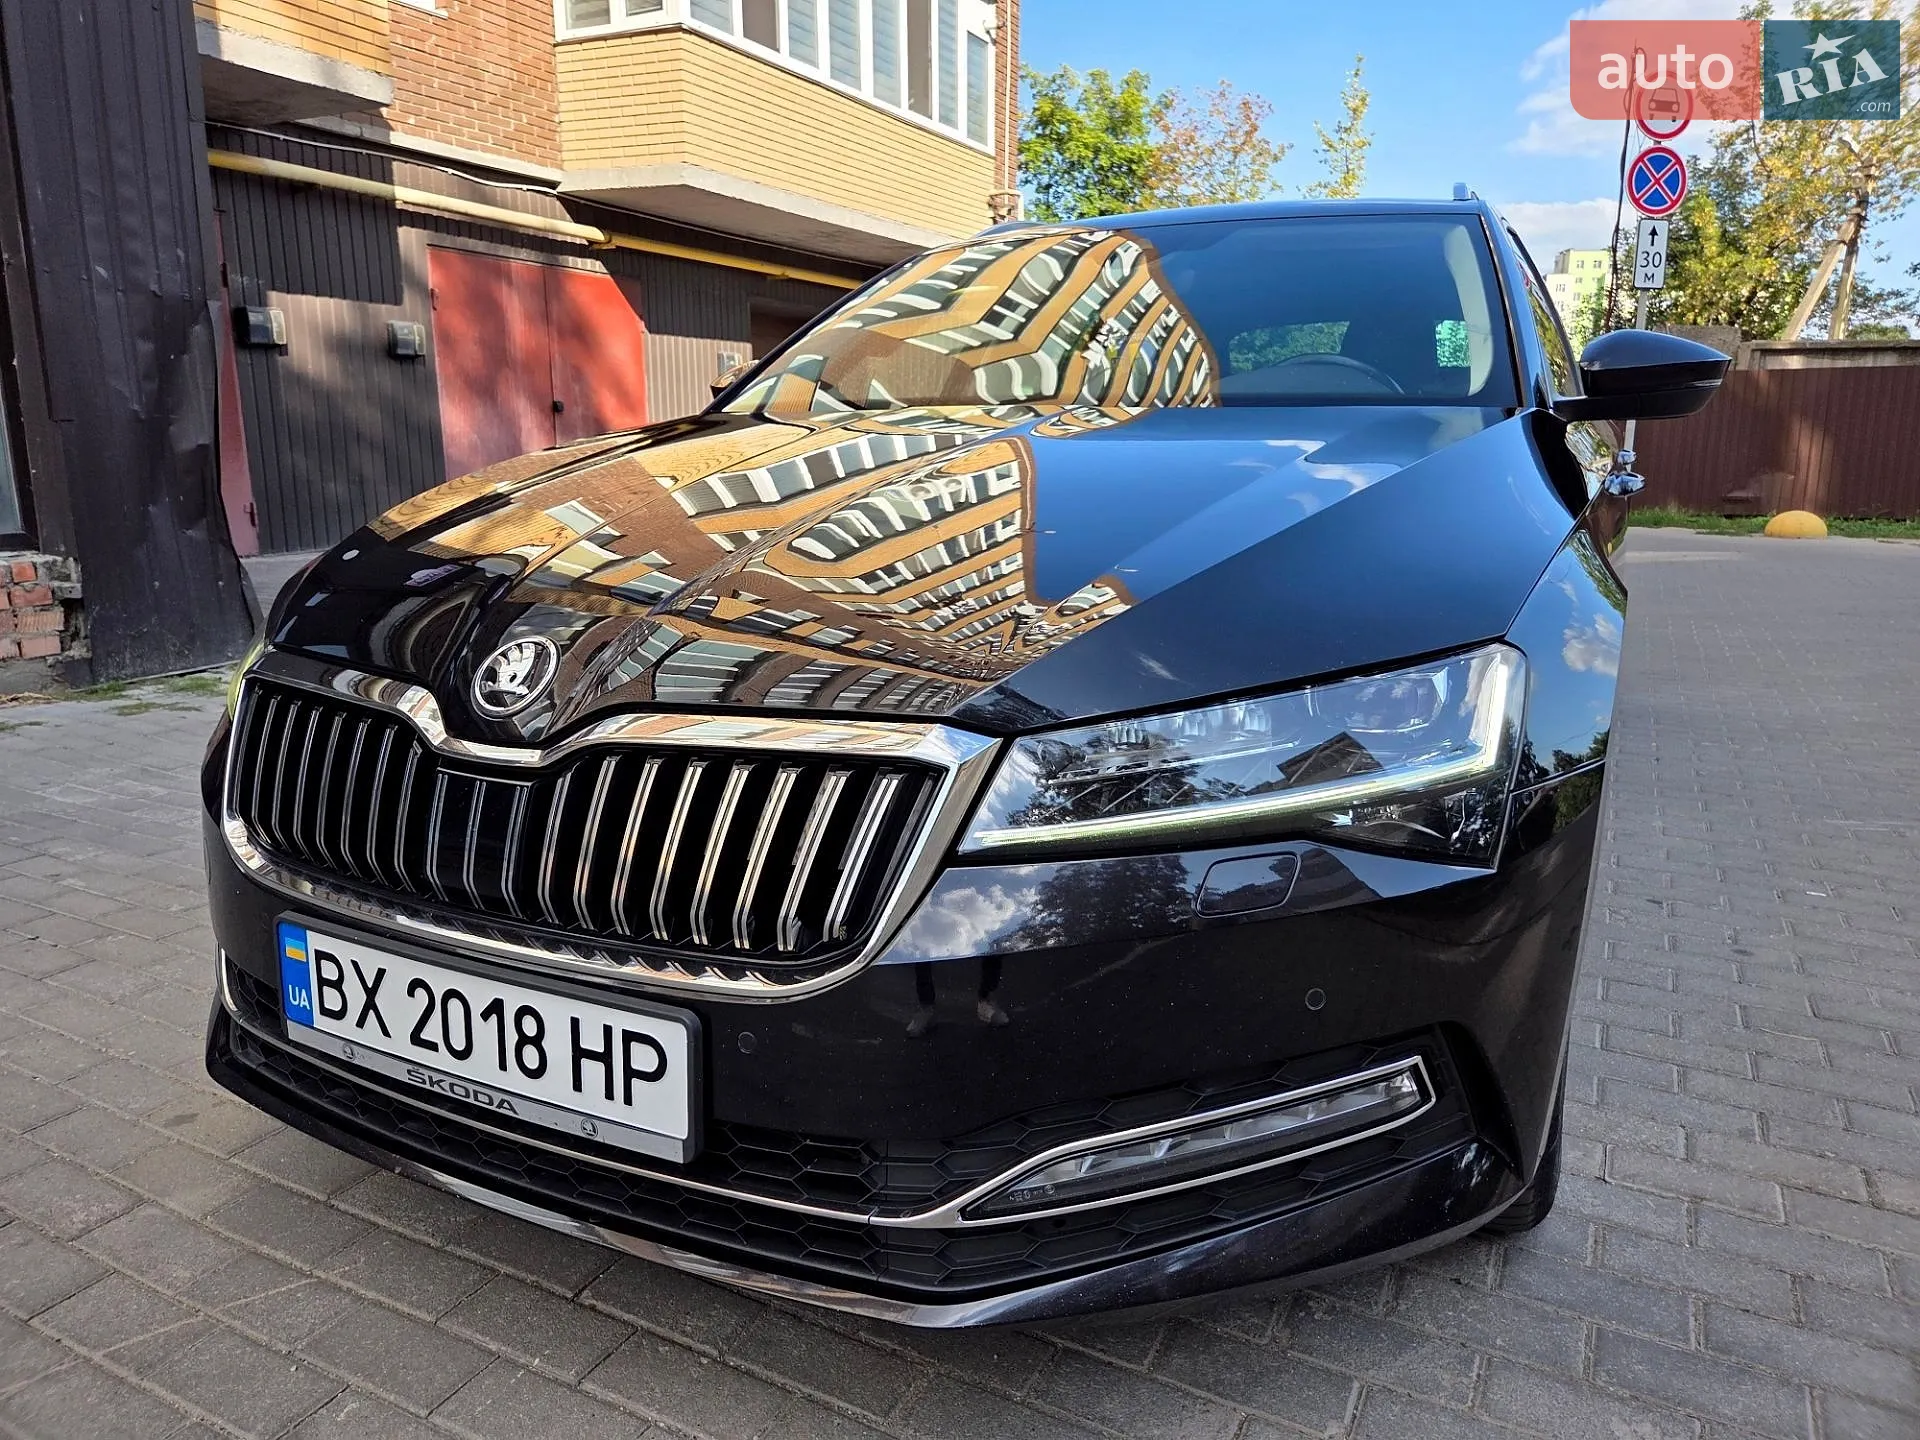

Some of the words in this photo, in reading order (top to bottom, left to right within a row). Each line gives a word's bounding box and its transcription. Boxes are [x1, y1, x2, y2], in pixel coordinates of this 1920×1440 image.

[1639, 250, 1663, 269] 30
[288, 984, 311, 1010] UA
[313, 948, 392, 1039] BX
[406, 977, 549, 1080] 2018
[570, 1016, 668, 1107] HP
[406, 1066, 519, 1116] ŠKODA
